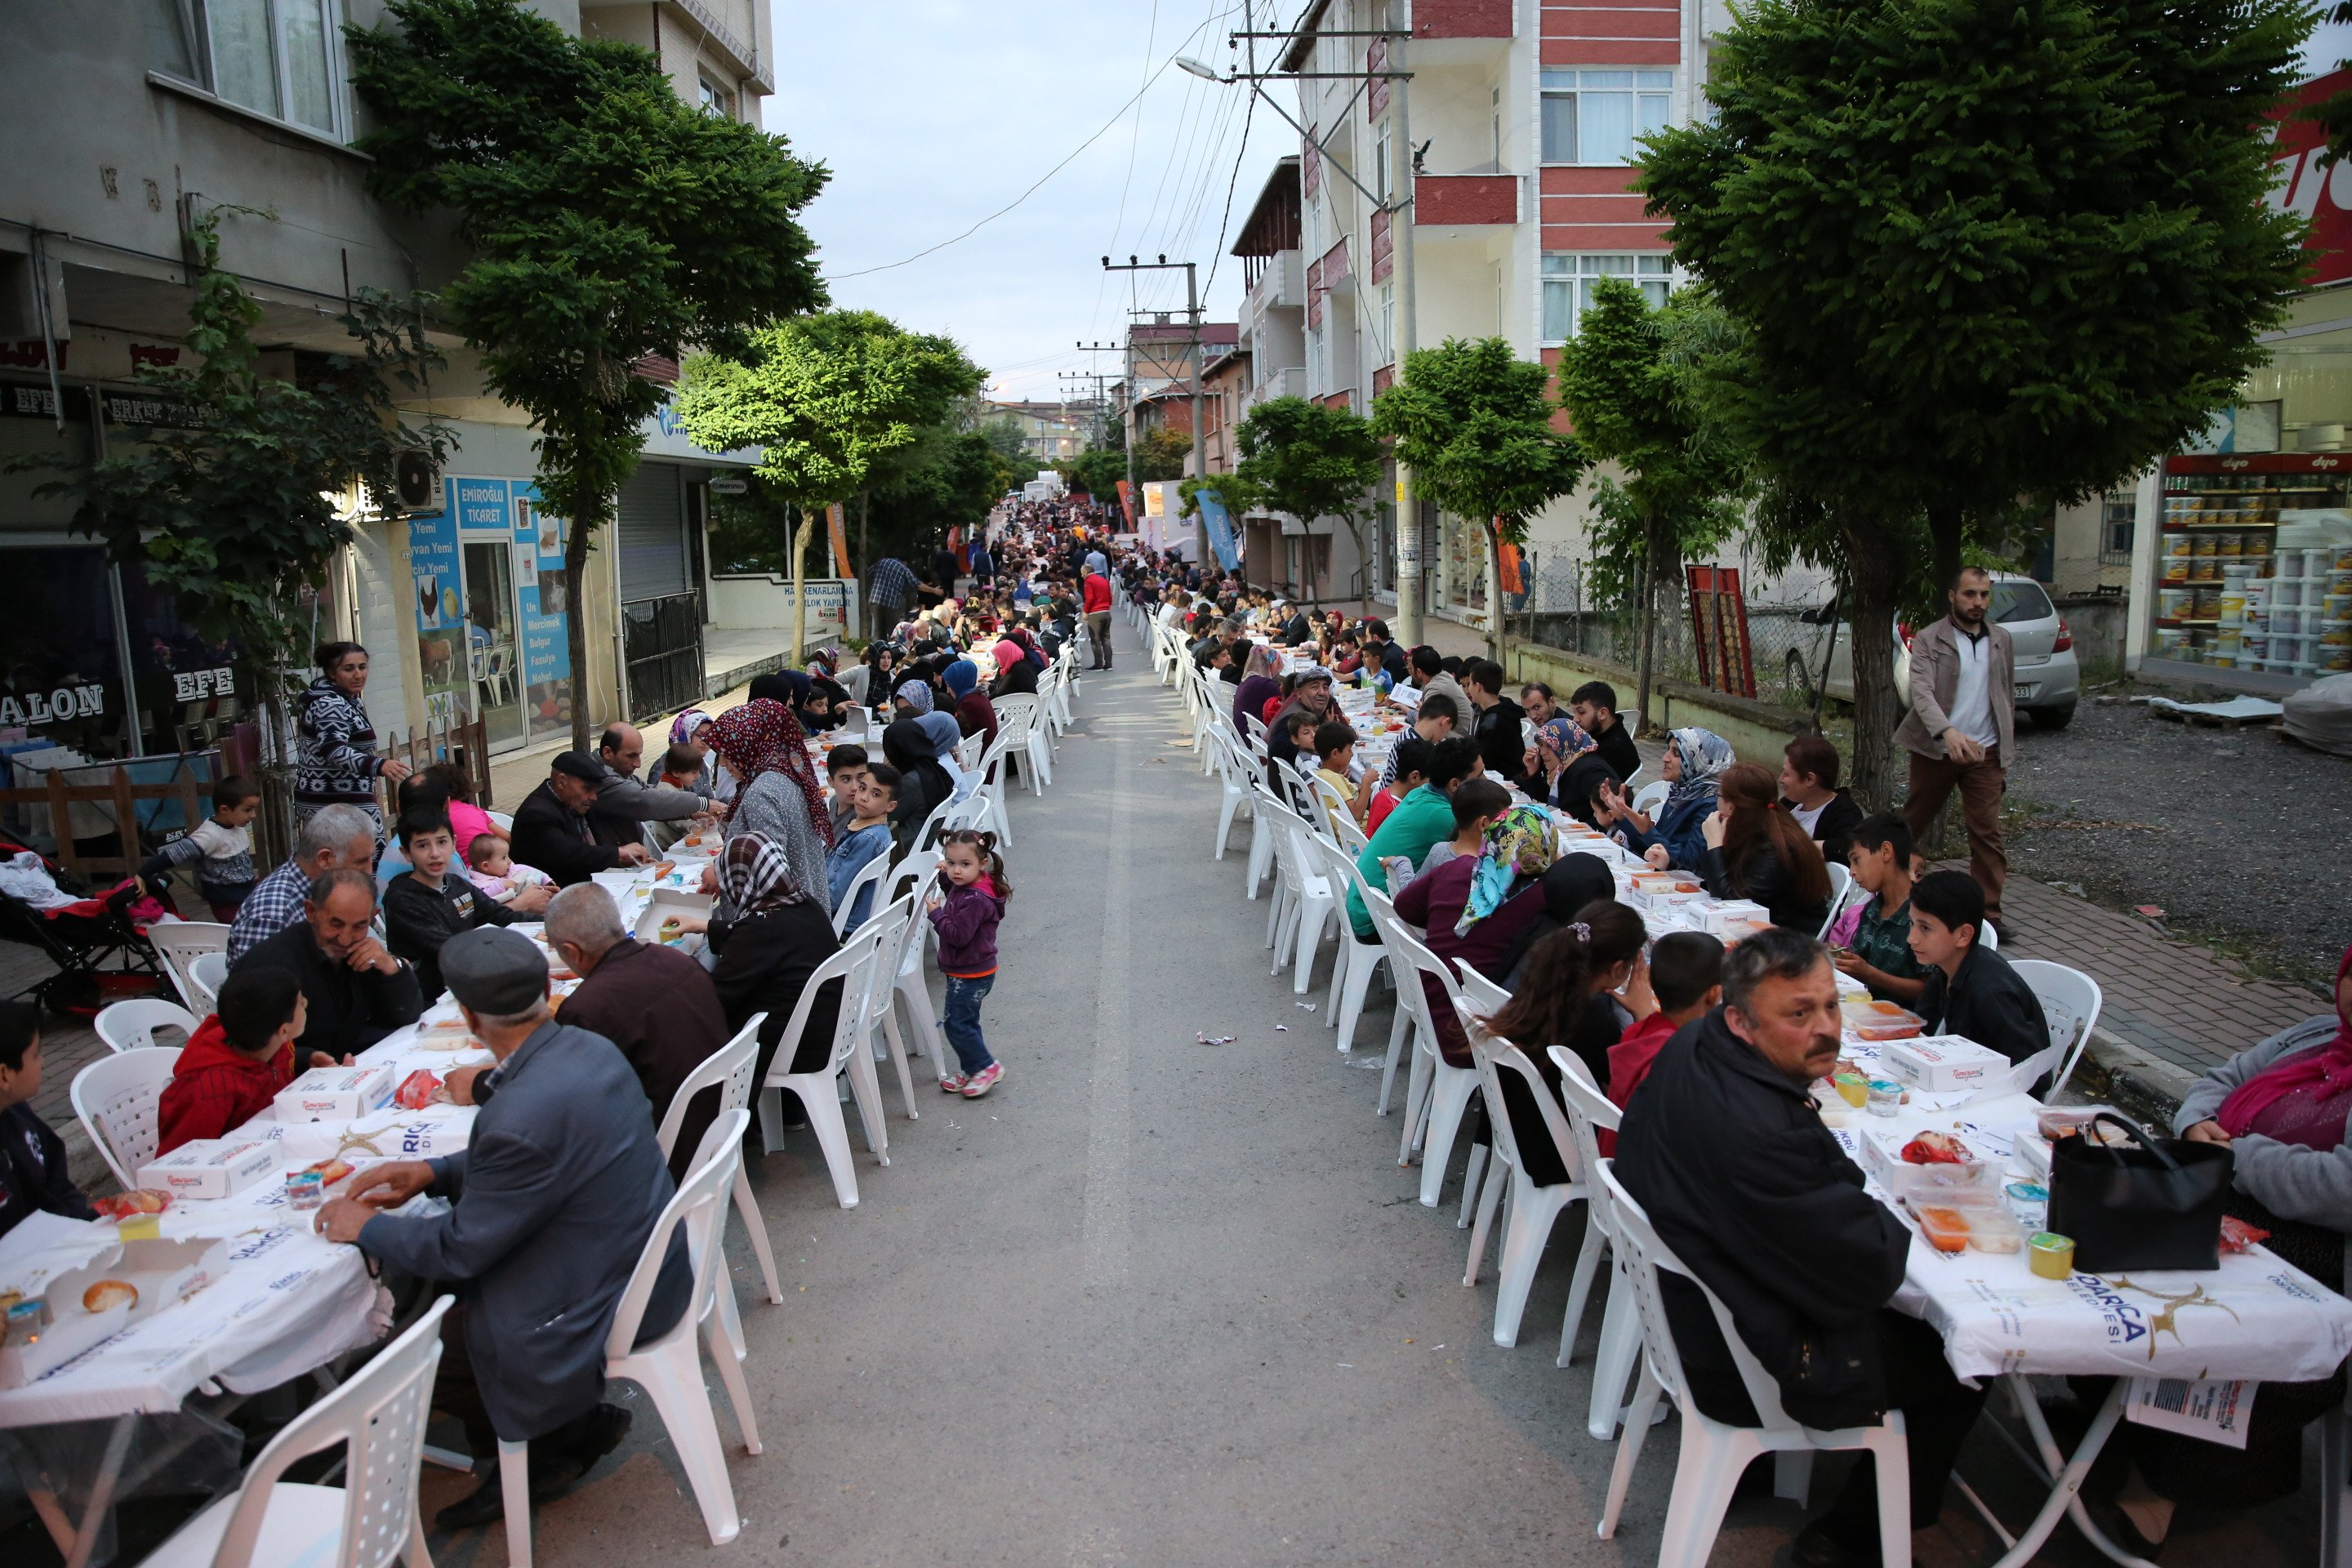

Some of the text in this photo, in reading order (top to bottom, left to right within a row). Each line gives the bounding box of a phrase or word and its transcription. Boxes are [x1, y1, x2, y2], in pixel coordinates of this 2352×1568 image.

[2221, 457, 2249, 470] dyo
[2312, 456, 2339, 470] dyo
[719, 482, 745, 490] merinos
[461, 485, 504, 504] EMİROĞLU
[467, 506, 501, 523] TİCARET
[414, 523, 436, 533] Yemi
[431, 542, 452, 554] Yemi
[427, 562, 448, 573] Yemi
[804, 586, 853, 595] KENARLARNA
[527, 603, 537, 612] Un
[823, 599, 851, 608] YAPILR
[528, 617, 561, 630] Mercimek
[529, 638, 551, 648] Bulgur
[531, 653, 556, 666] Fasulye
[173, 666, 235, 702] EFE
[532, 671, 552, 684] Nohut
[2075, 1275, 2146, 1343] DARICA
